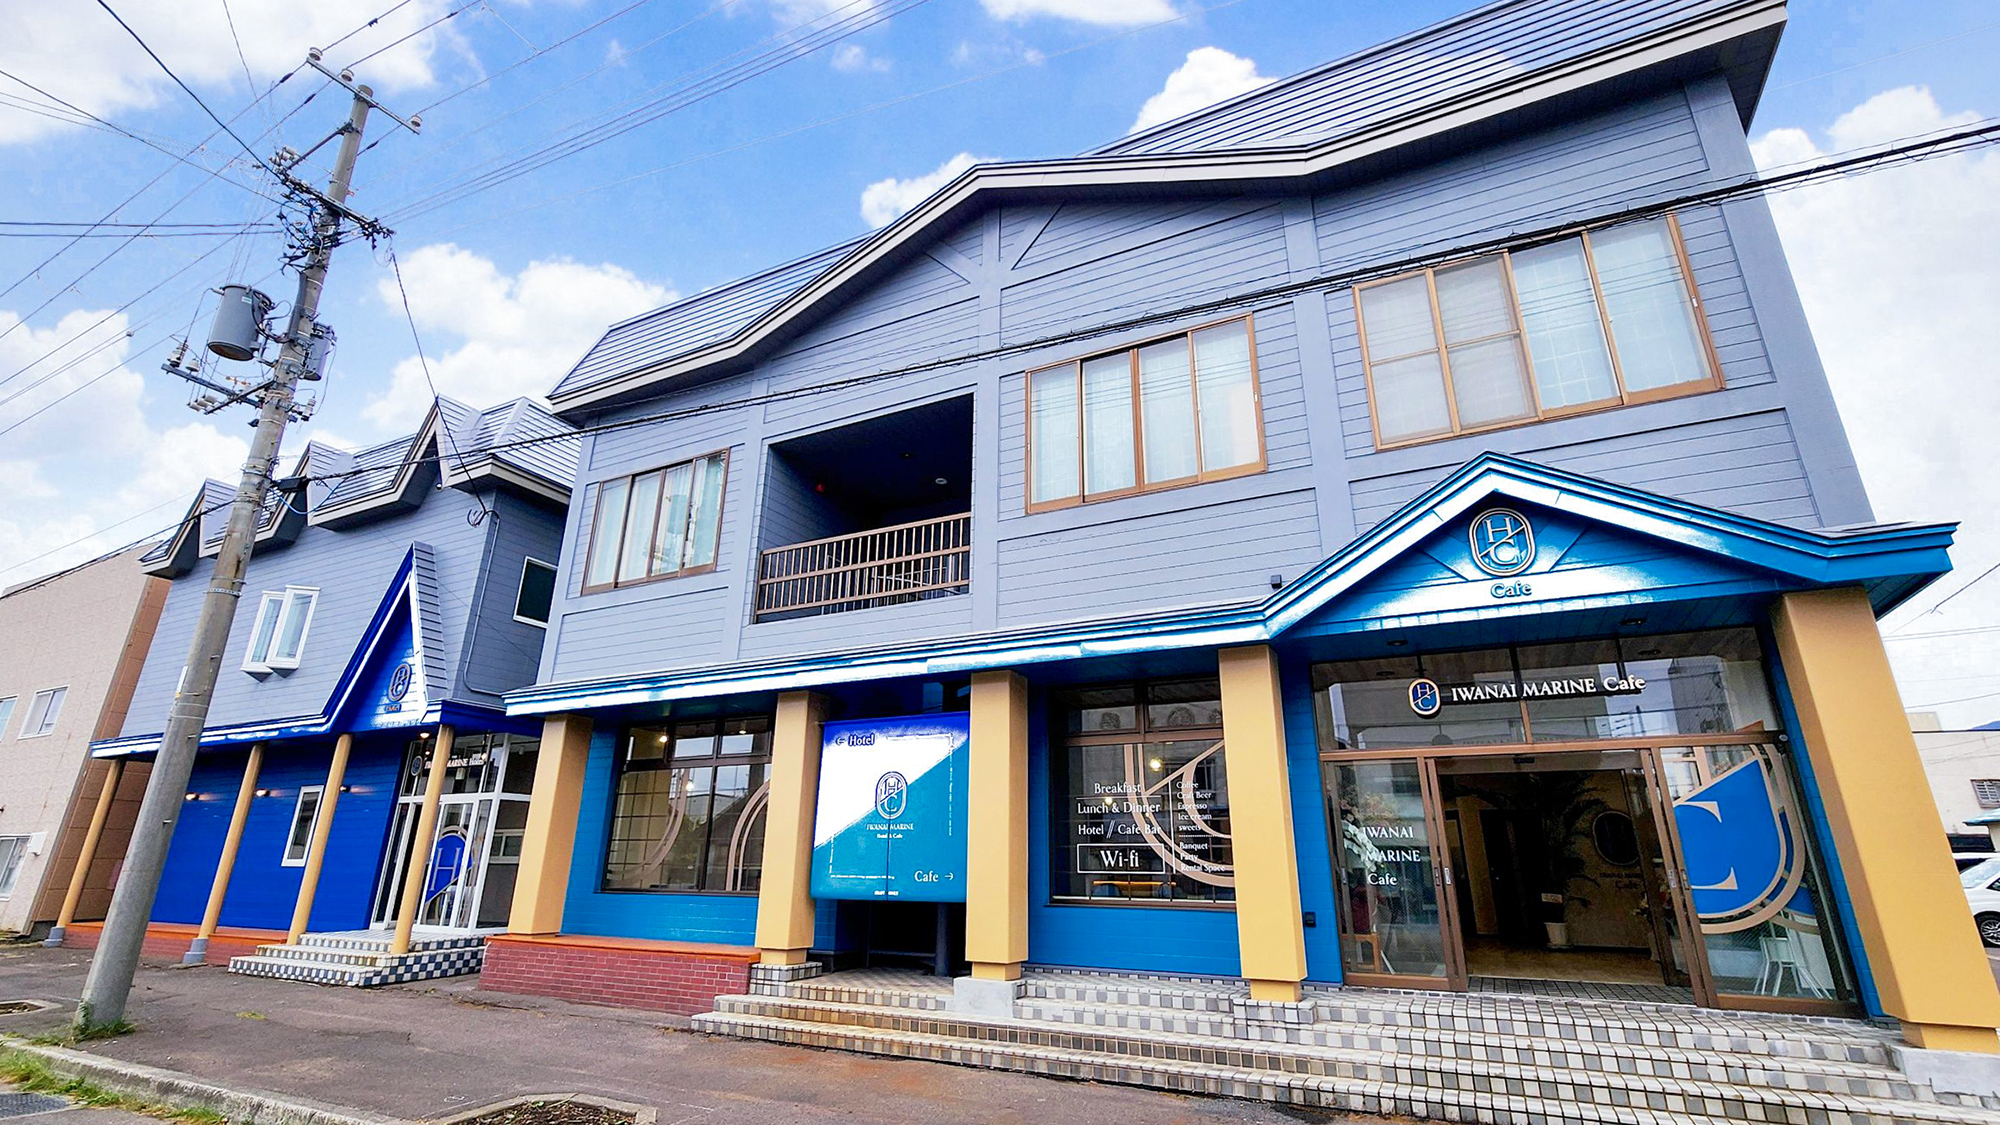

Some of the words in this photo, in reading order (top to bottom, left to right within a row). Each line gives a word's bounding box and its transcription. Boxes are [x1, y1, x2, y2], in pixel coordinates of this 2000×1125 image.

[1490, 580, 1532, 599] Cafe
[1451, 684, 1517, 702] IWANAI
[1523, 678, 1596, 697] MARINE
[1603, 674, 1647, 692] Cafe
[848, 733, 875, 747] Hotel
[1094, 782, 1141, 794] Breakfast
[1176, 781, 1199, 789] Coffee
[1176, 791, 1194, 799] Craft
[1195, 791, 1212, 799] Beer
[1077, 803, 1109, 814] Lunch
[1111, 803, 1120, 813] &
[1123, 801, 1160, 813] Dinner
[1177, 802, 1208, 812] Espresso
[1178, 813, 1189, 821] Ice
[1078, 823, 1104, 835] Hotel
[1117, 824, 1141, 835] Cafe
[1144, 823, 1162, 834] Bar
[1179, 841, 1208, 851] Banquet
[1100, 850, 1139, 868] Wi-fi
[1180, 853, 1199, 862] Party
[1180, 864, 1203, 872] Rental
[1203, 864, 1226, 874] Space
[914, 870, 939, 882] Cafe
[1367, 872, 1398, 885] Cafe
